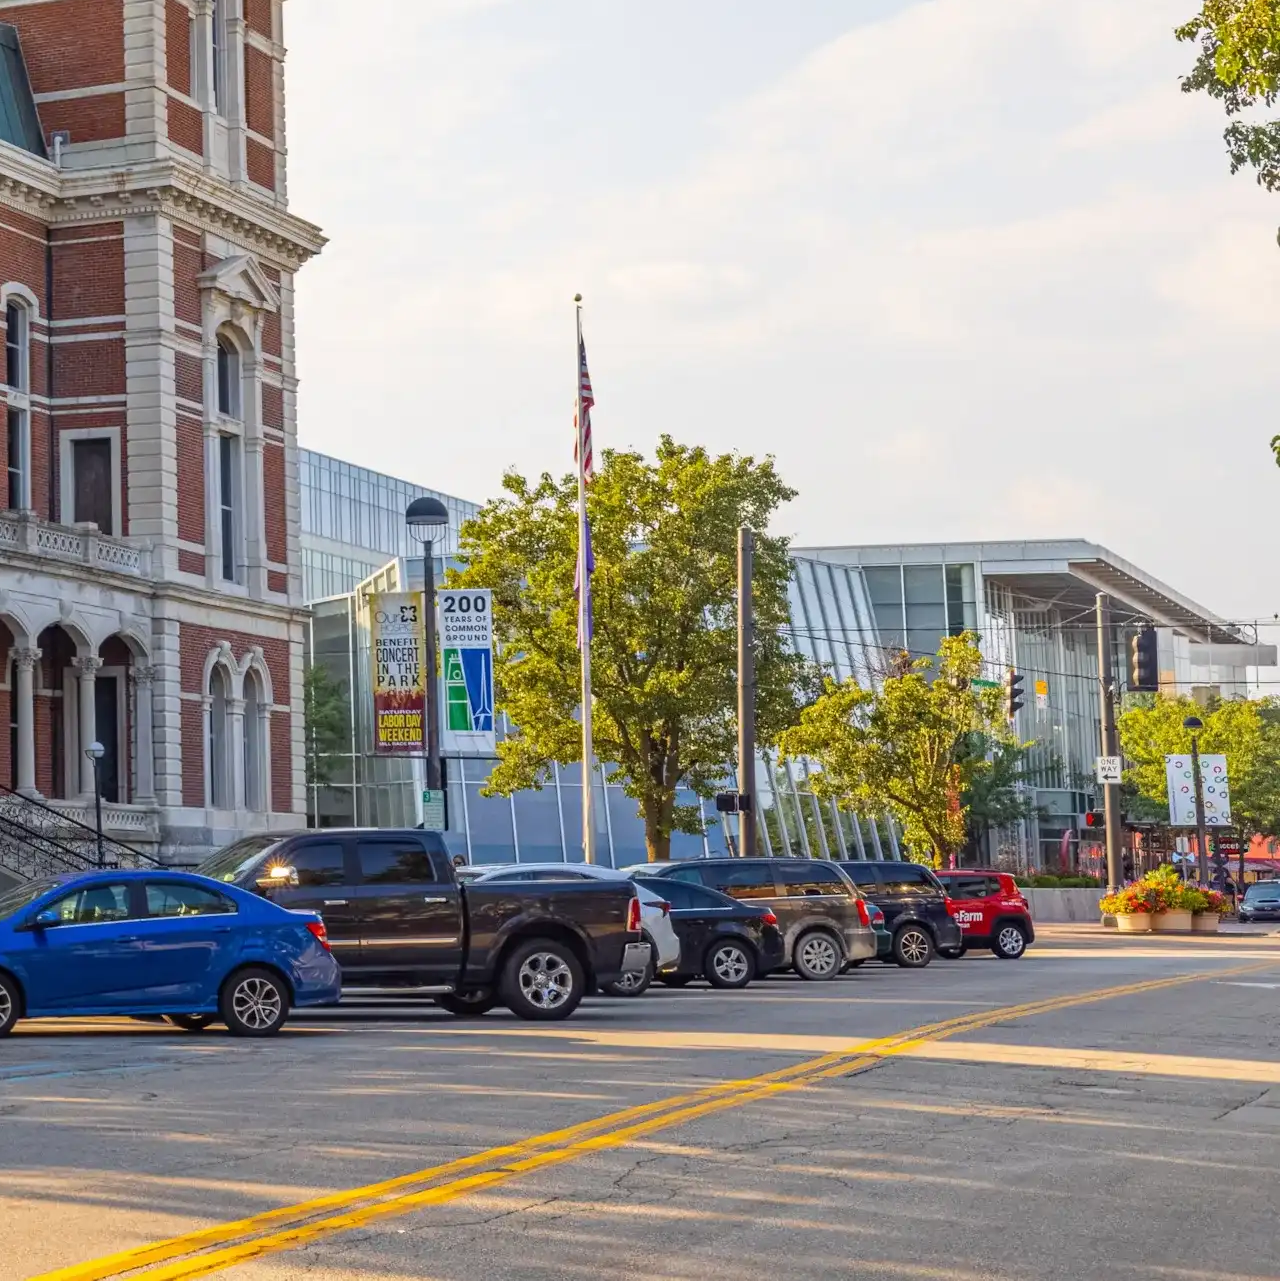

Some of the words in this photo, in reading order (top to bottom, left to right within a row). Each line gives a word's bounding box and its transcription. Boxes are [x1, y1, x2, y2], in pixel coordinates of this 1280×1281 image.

[444, 596, 486, 613] 200
[376, 638, 418, 646] BENEFIT
[376, 647, 419, 662] CONCERT
[377, 663, 389, 674] IN
[397, 663, 420, 674] THE
[377, 675, 420, 687] PARK
[379, 714, 405, 727] LABOR
[405, 714, 421, 727] DAY
[379, 728, 422, 741] WEEKEND
